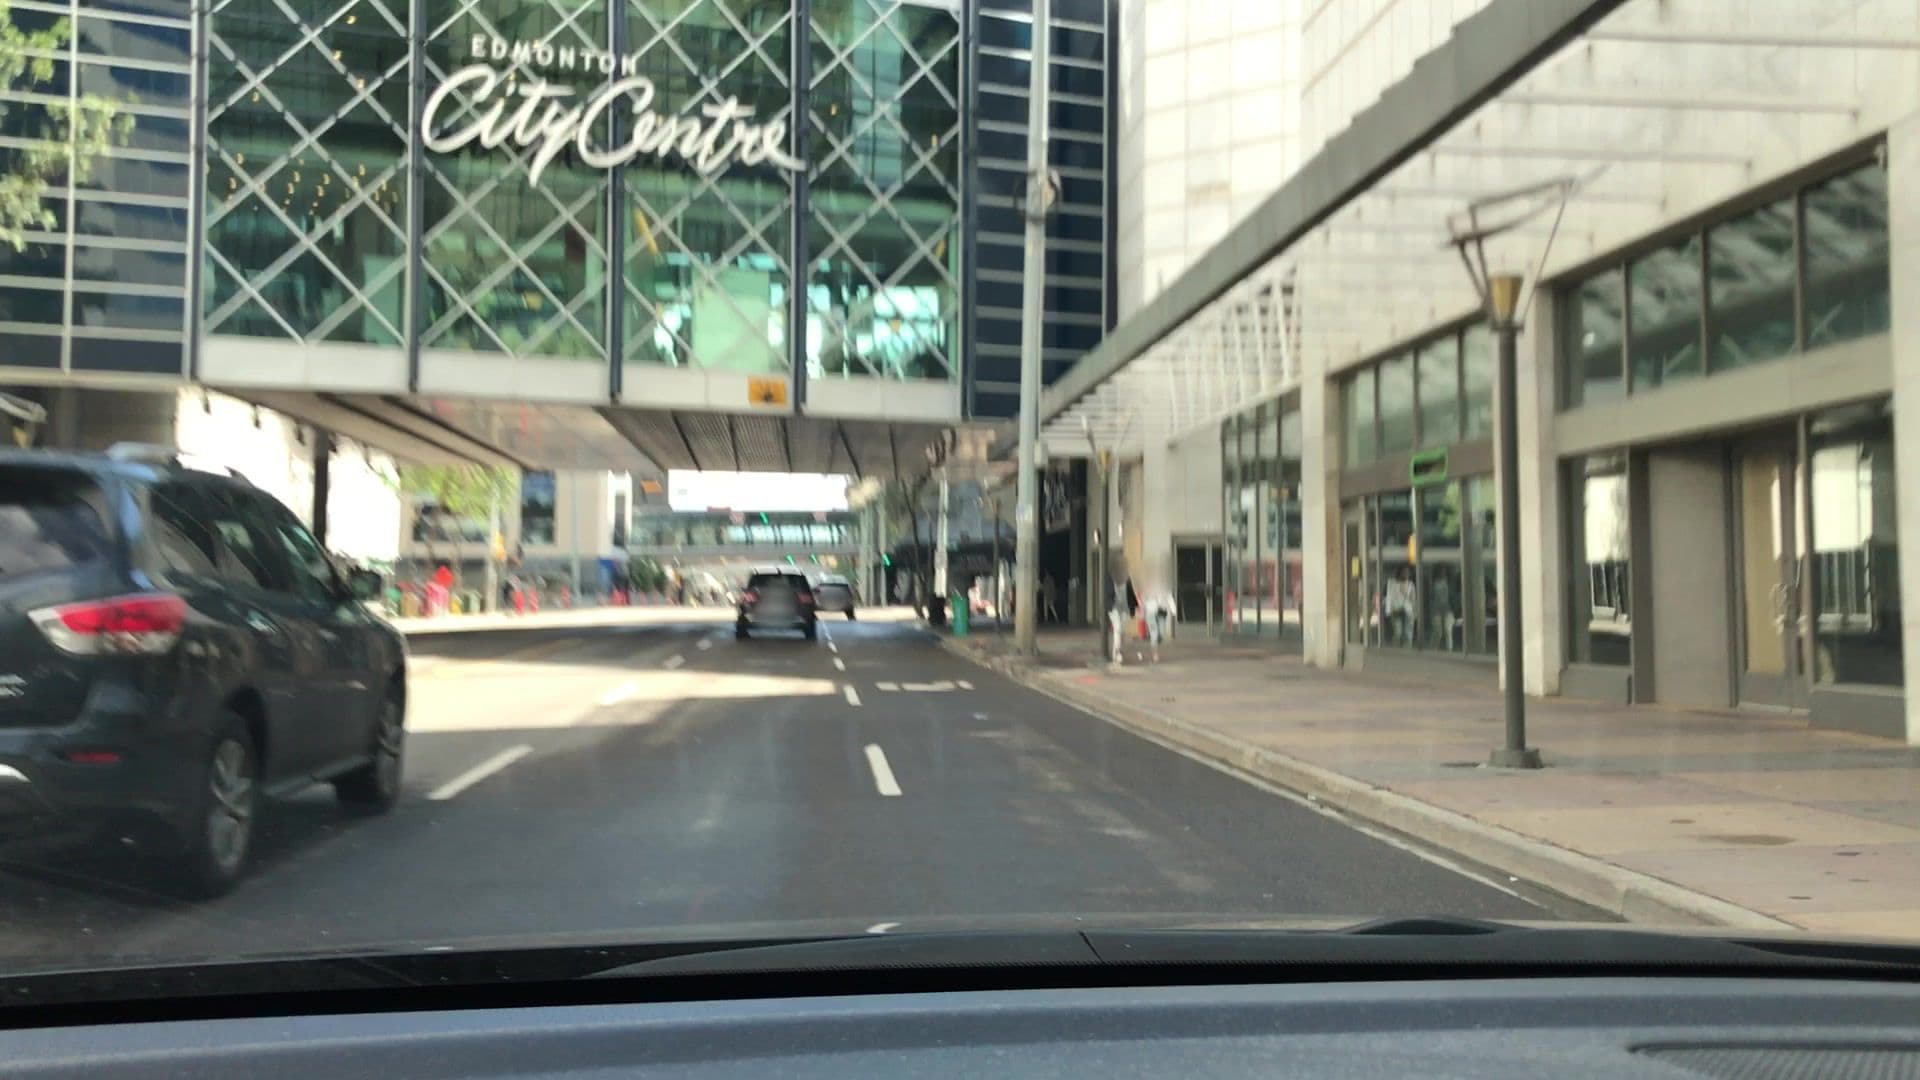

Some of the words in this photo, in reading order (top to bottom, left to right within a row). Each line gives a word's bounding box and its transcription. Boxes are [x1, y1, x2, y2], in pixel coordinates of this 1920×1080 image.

[471, 33, 637, 76] EDMONTON
[421, 63, 583, 188] City
[577, 76, 807, 175] Centre
